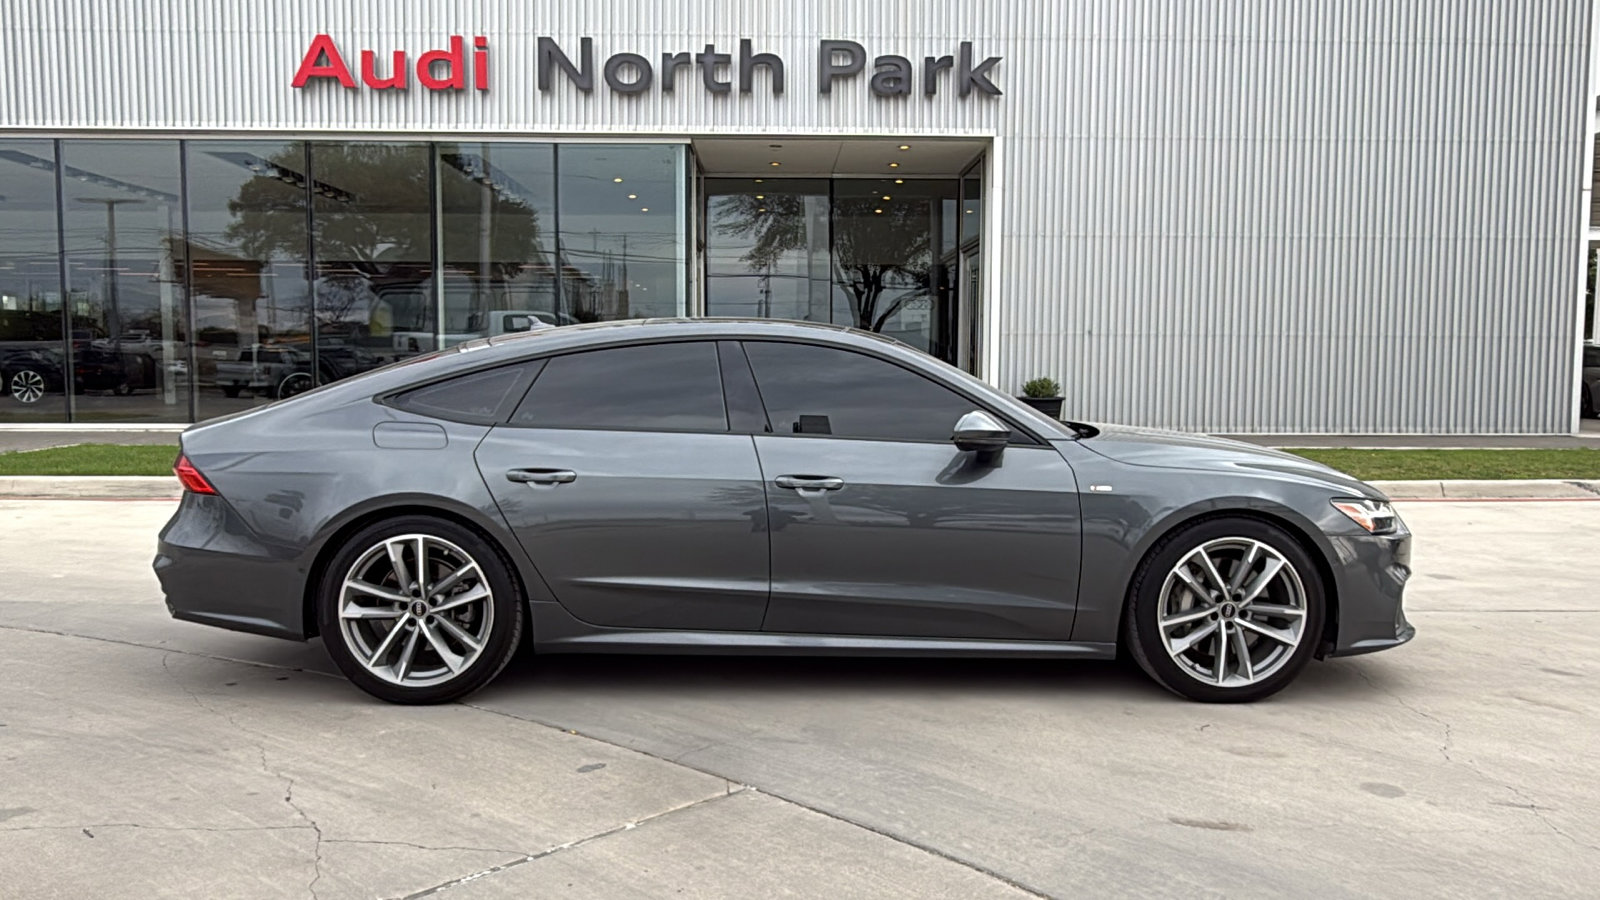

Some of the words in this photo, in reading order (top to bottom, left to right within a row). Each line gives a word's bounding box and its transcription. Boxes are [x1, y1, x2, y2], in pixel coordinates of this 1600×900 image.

[292, 34, 490, 91] Audi
[538, 36, 784, 96] North
[820, 39, 1004, 98] Park
